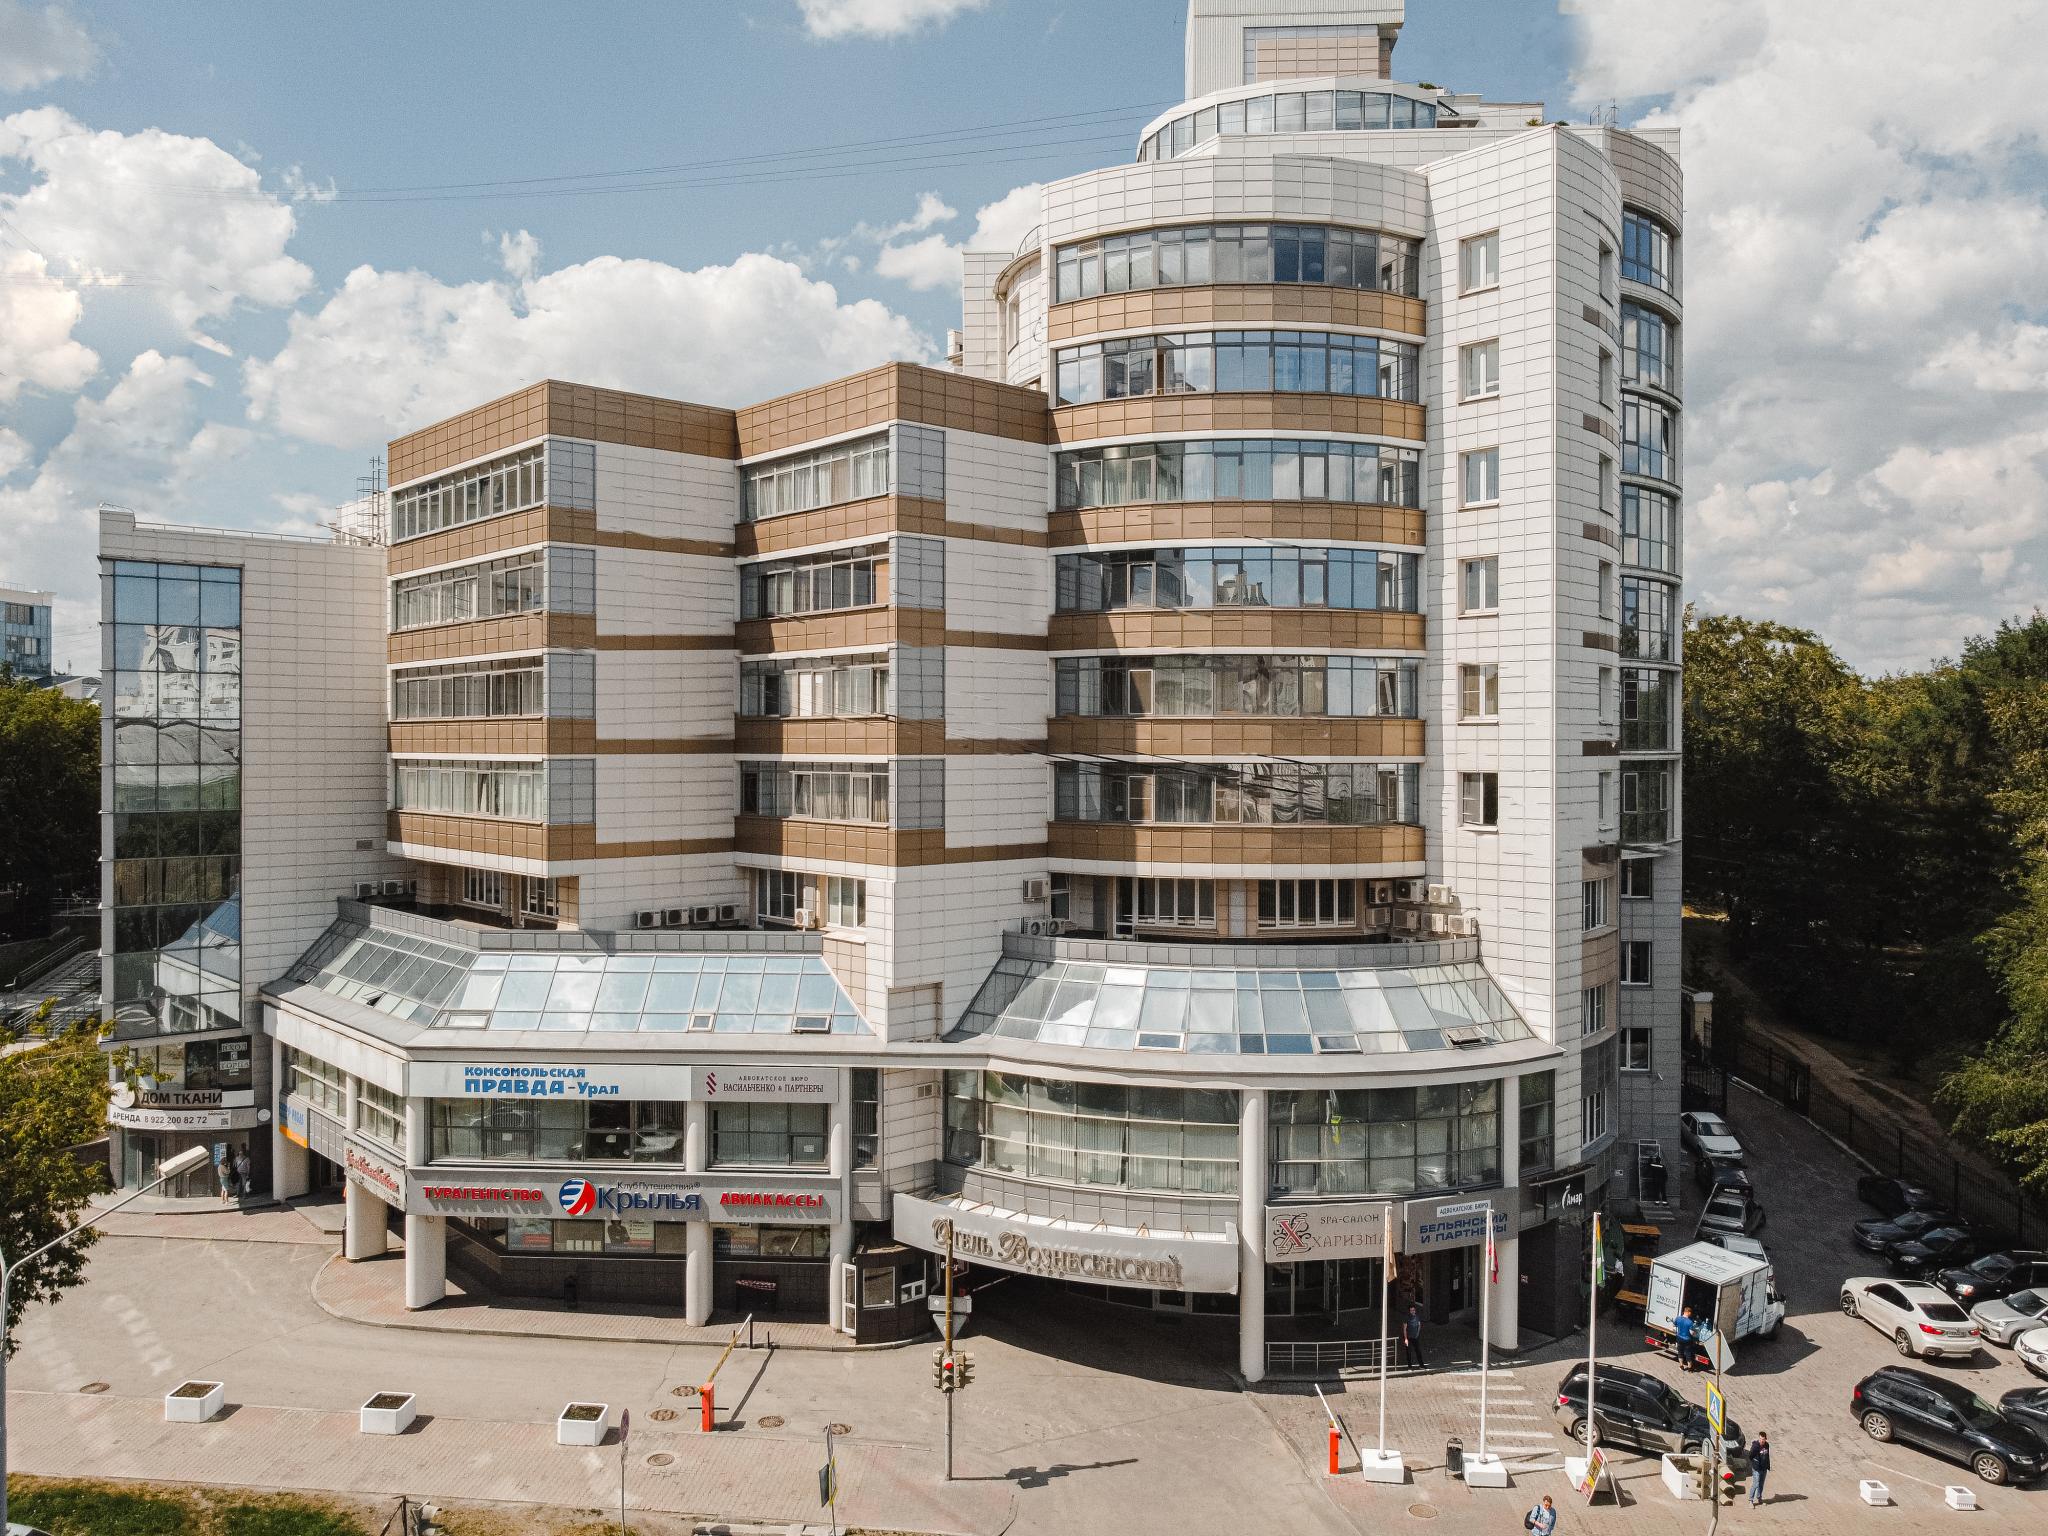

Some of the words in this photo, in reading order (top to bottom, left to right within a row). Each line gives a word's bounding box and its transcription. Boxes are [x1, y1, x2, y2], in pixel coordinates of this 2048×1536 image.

[464, 1066, 586, 1078] КОМСОМОЛЬСКАЯ
[464, 1079, 564, 1095] ПРАВДА
[723, 1083, 776, 1092] ВАСИЛЬЧЕНКО
[784, 1084, 824, 1093] ПАРТНЕРЫ
[141, 1092, 170, 1105] ДОМ
[174, 1092, 222, 1105] ТКАНИ
[112, 1111, 141, 1123] АРЕНДА
[151, 1115, 165, 1124] 922
[167, 1116, 181, 1124] 200
[184, 1116, 194, 1124] 82
[197, 1115, 208, 1124] 72
[423, 1186, 544, 1201] ТУРАГЕНТСТВО
[720, 1193, 823, 1207] АВИАКАССЫ
[598, 1187, 701, 1214] Крылья
[1421, 1234, 1430, 1243] И
